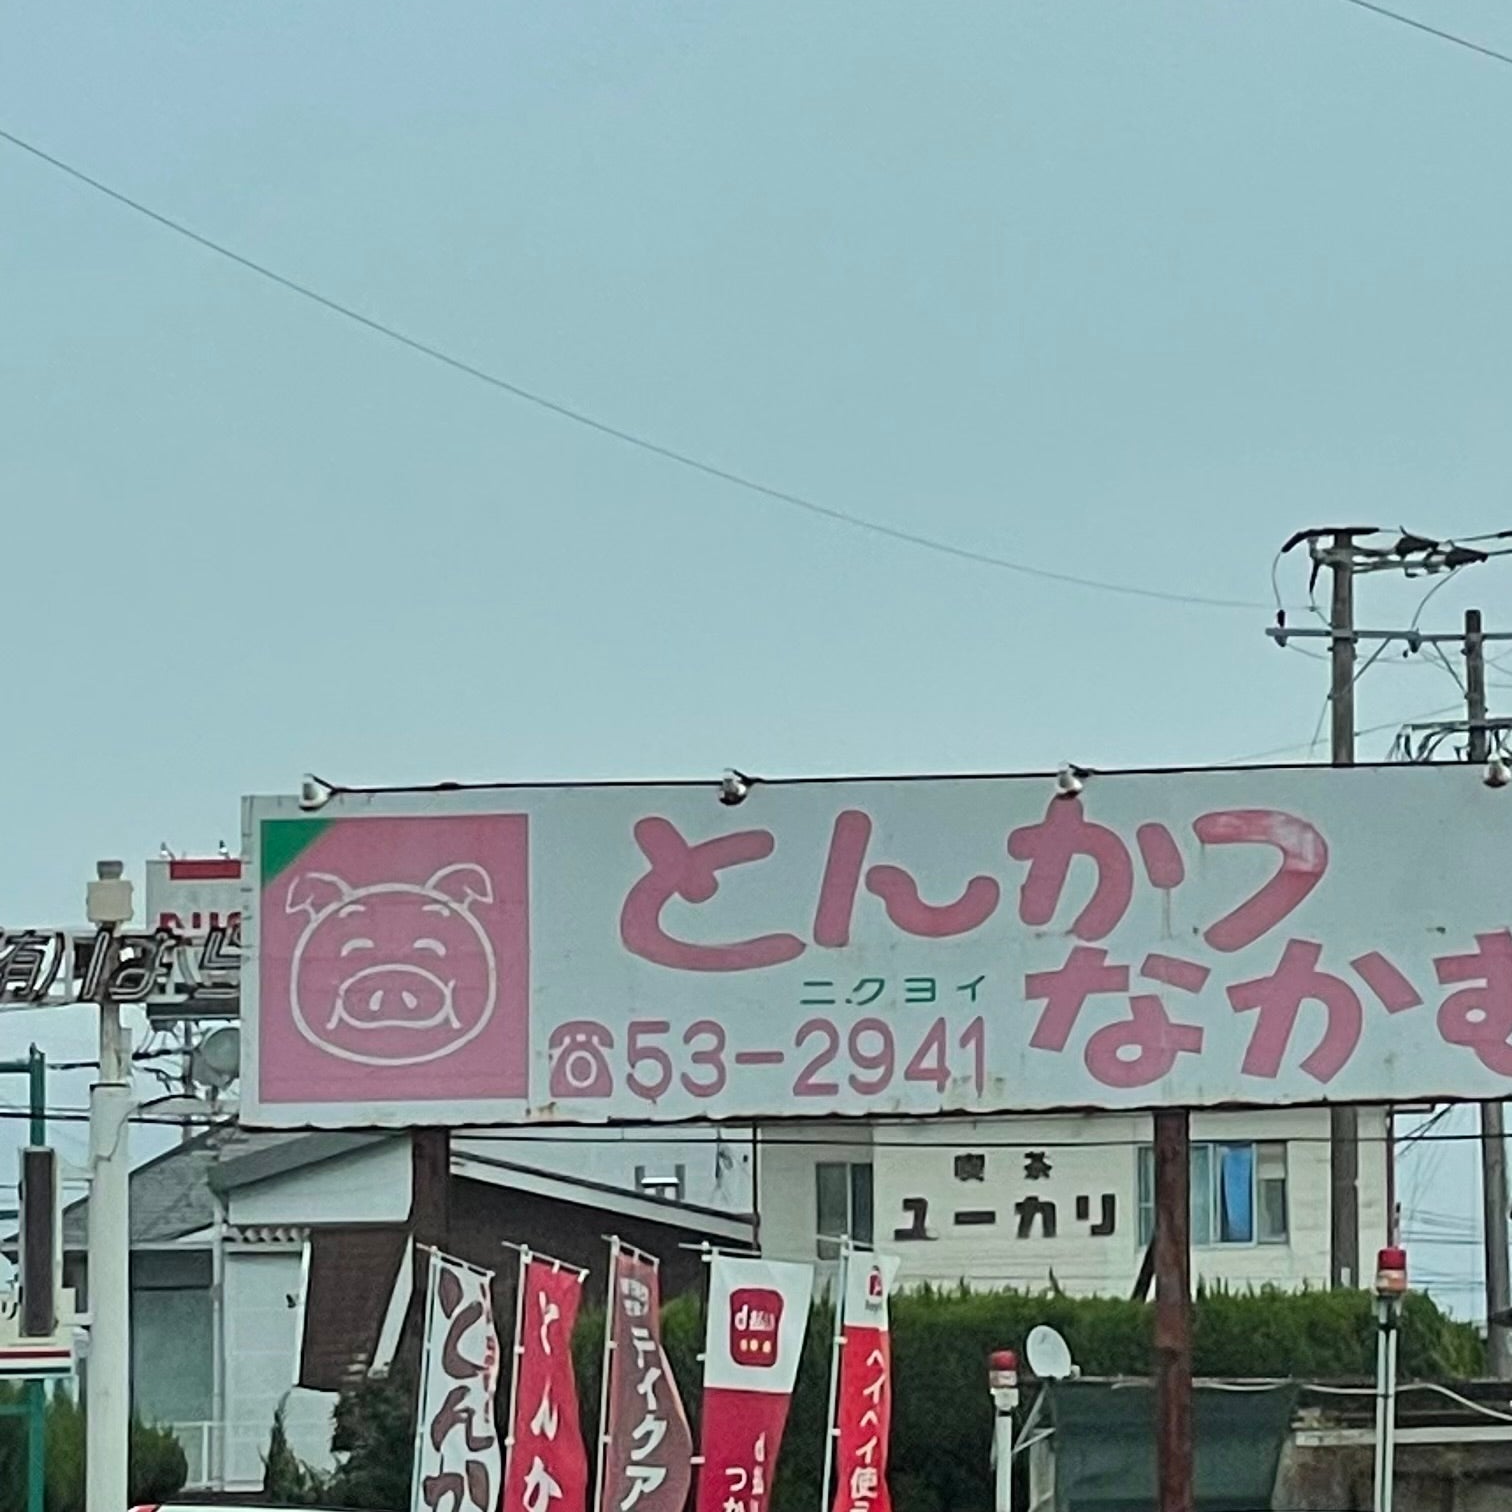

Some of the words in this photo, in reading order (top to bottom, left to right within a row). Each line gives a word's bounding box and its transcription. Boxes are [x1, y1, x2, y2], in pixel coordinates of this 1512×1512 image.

[619, 794, 1329, 973] とんかつ
[799, 975, 986, 1006] ニクヨイ
[893, 1193, 1117, 1241] ユーカリ
